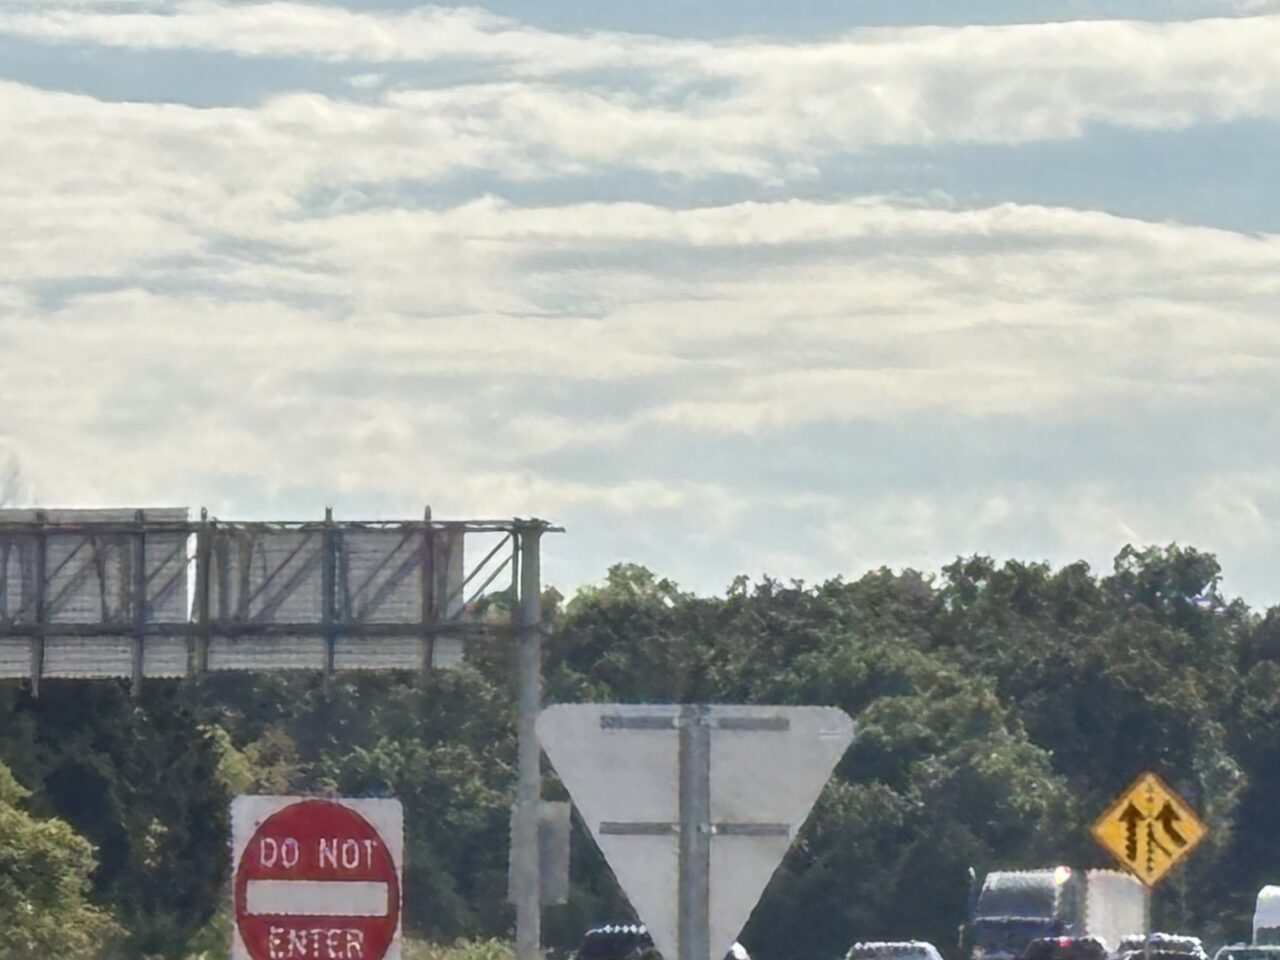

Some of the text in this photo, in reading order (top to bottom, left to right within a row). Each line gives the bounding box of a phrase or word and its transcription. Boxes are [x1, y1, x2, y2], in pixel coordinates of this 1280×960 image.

[260, 837, 377, 869] DO NOT
[268, 925, 363, 959] ENTER
